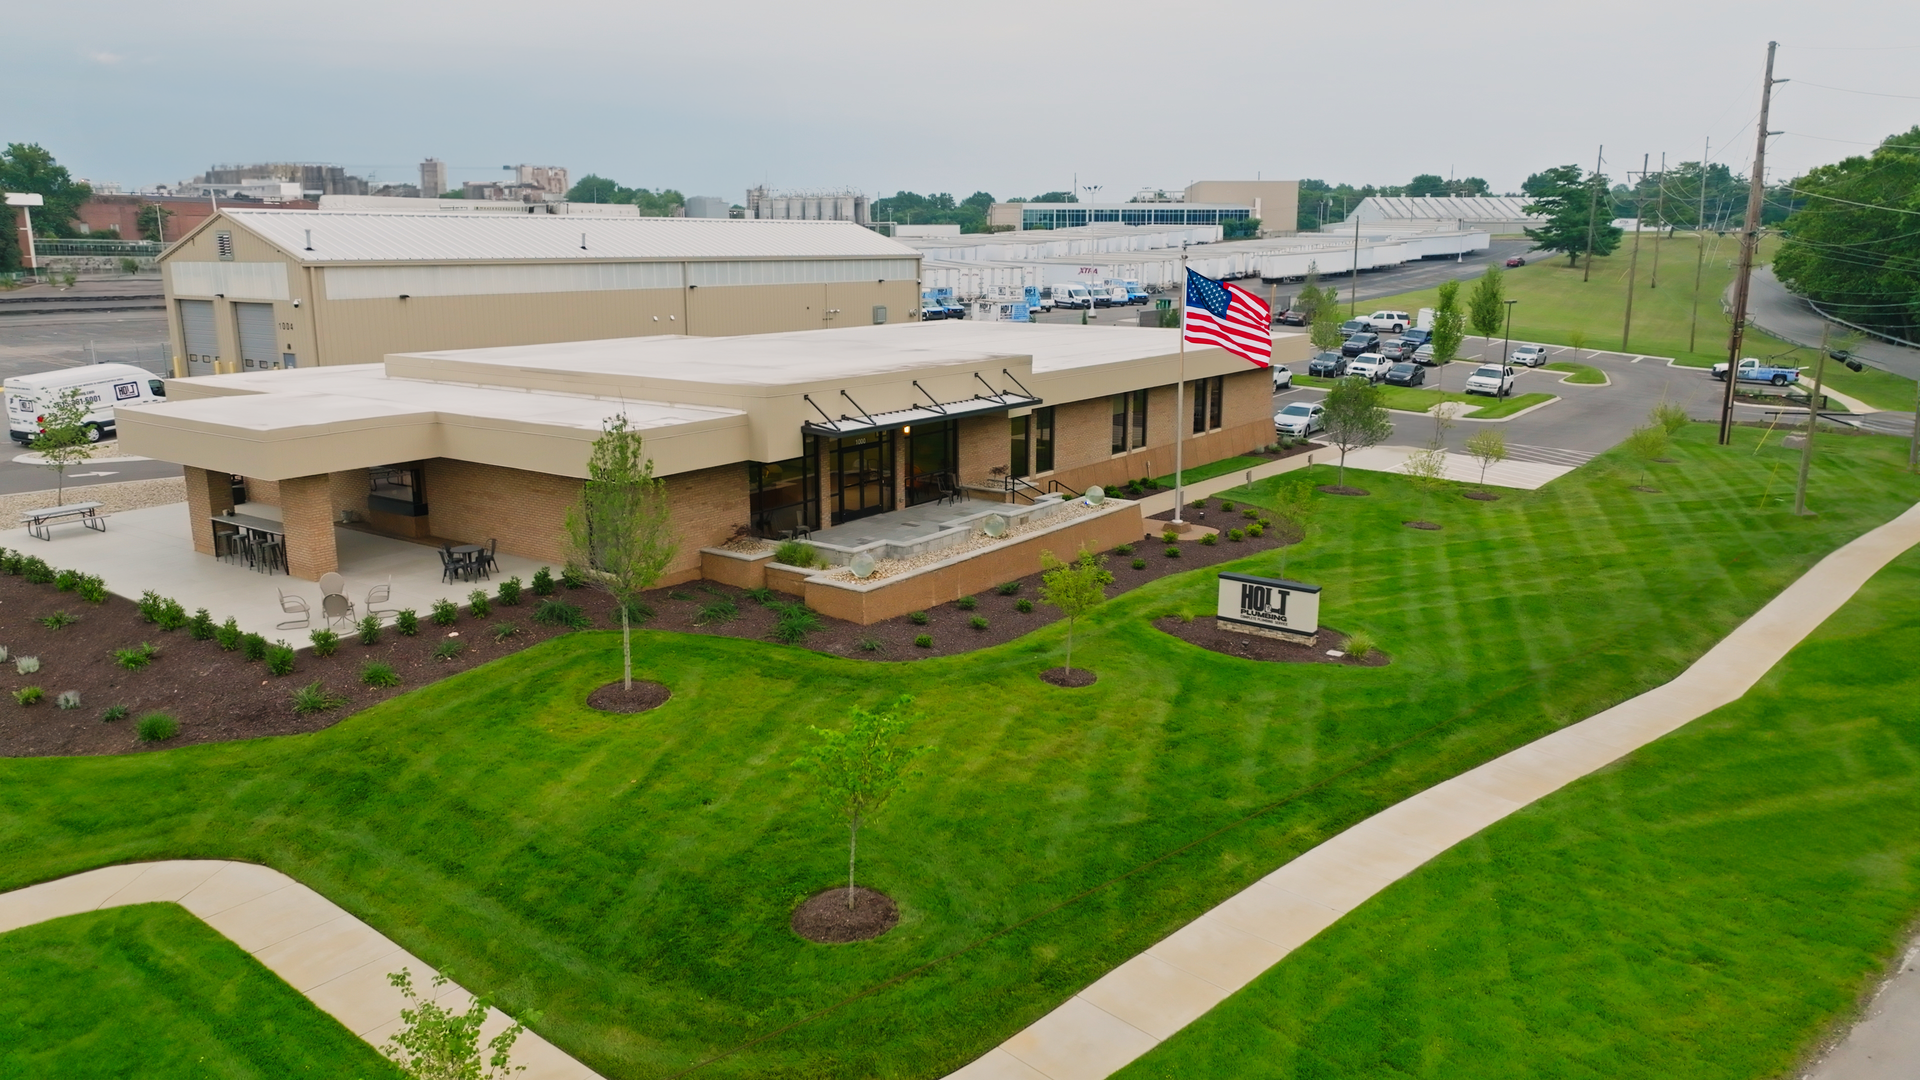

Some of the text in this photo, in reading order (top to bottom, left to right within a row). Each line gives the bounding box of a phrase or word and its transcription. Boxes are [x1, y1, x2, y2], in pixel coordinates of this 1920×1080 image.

[278, 322, 294, 331] 1004
[118, 385, 135, 396] HOLT
[1241, 584, 1290, 615] HOLT
[1241, 609, 1287, 622] PLUMBING
